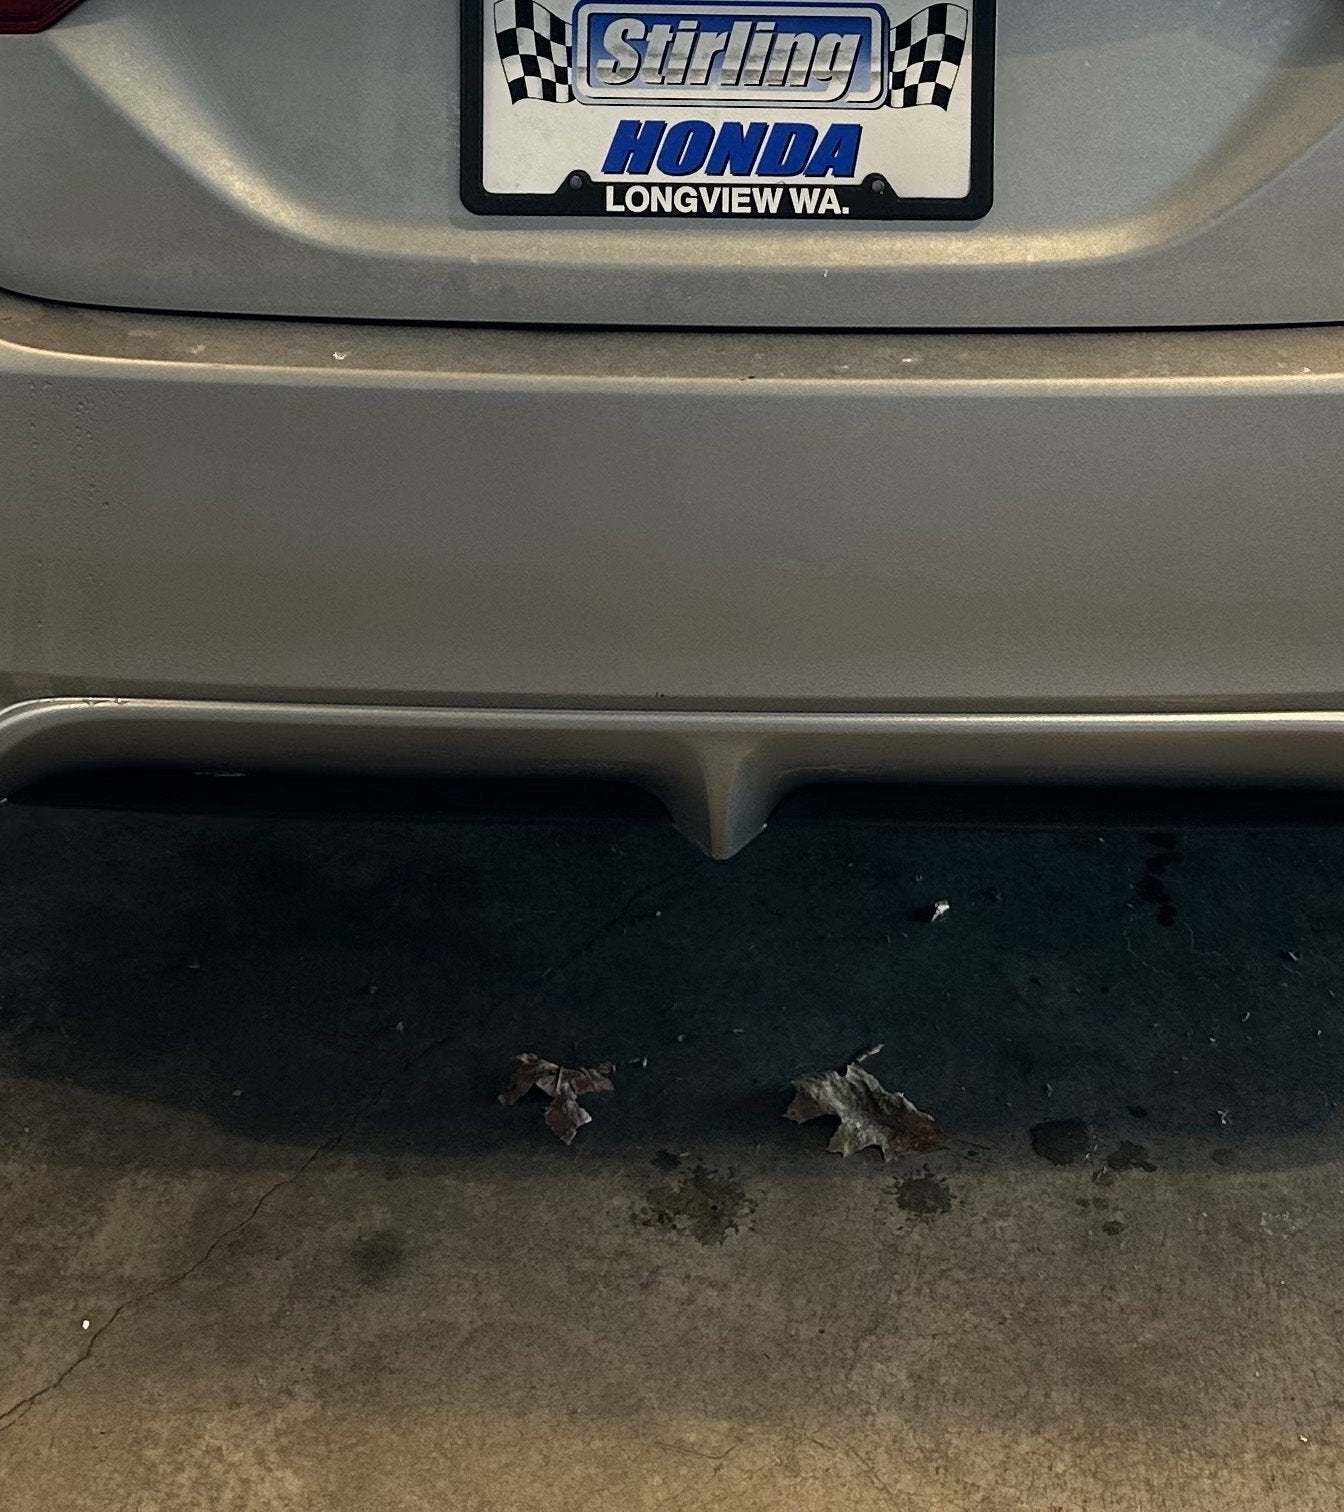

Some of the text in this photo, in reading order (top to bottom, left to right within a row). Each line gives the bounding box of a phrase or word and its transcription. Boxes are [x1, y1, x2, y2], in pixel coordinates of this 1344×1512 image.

[595, 16, 864, 102] Stirling
[601, 119, 864, 178] HONDA
[605, 185, 850, 215] LONGVIEW WA.
